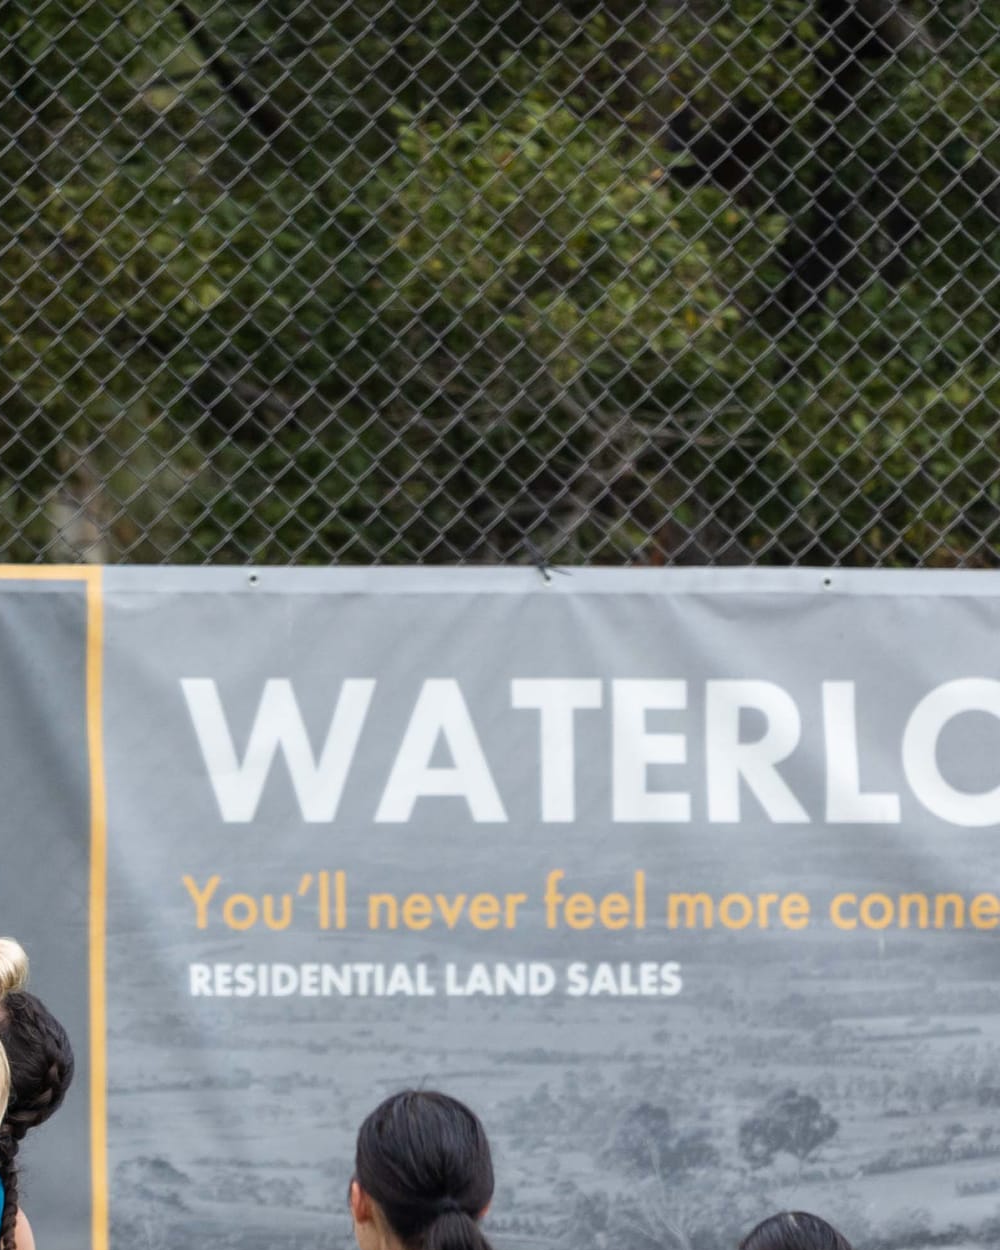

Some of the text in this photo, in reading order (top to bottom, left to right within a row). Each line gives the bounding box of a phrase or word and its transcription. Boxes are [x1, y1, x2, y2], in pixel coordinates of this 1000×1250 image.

[180, 676, 1000, 828] WATERLO
[182, 869, 1000, 930] You'll never feel more conne
[189, 961, 683, 997] RESIDENTIAL LAND SALES
